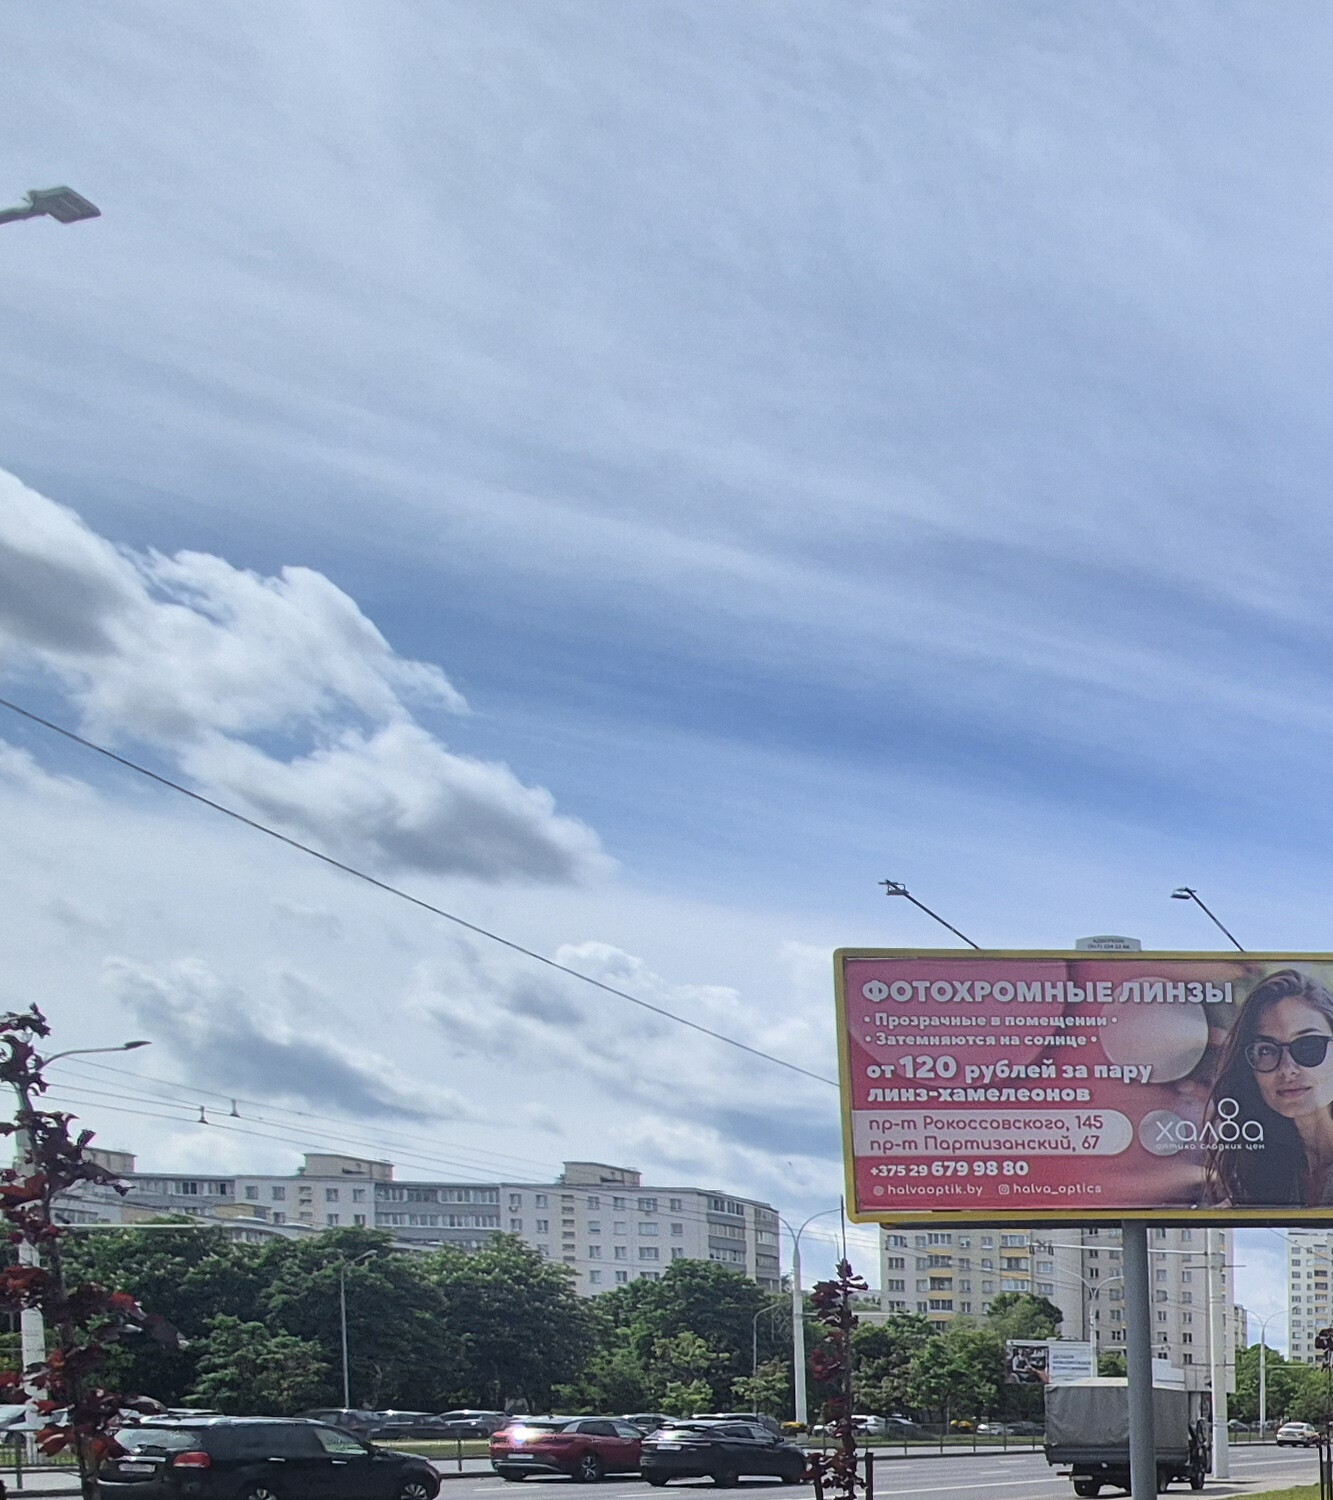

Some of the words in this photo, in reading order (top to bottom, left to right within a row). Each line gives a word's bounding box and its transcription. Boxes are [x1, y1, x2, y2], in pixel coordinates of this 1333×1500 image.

[862, 980, 1113, 1004] ФОТОХРОМНЫЕ
[1119, 981, 1233, 1004] ЛИНЗЫ
[875, 1012, 987, 1029] Прозрачные
[991, 1016, 1001, 1026] в
[1005, 1016, 1108, 1029] помещении
[876, 1032, 996, 1046] Затемняются
[1000, 1034, 1020, 1045] на
[1024, 1035, 1088, 1048] солнце
[866, 1065, 895, 1079] от
[899, 1055, 957, 1079] 120
[965, 1059, 1057, 1084] рублей
[1062, 1064, 1088, 1079] за
[1094, 1064, 1153, 1084] пару
[868, 1087, 1091, 1102] линз-хамелеонов
[869, 1118, 917, 1134] пр-т
[923, 1115, 1070, 1133] Рокоссовского,
[1075, 1115, 1104, 1130] 145
[870, 1139, 918, 1154] пр-т
[924, 1135, 1077, 1154] Партизанский,
[1081, 1135, 1101, 1150] 67
[870, 1165, 906, 1177] +375
[909, 1165, 928, 1177] 29
[931, 1161, 969, 1177] 679
[973, 1161, 998, 1176] 98
[1002, 1160, 1029, 1176] 80
[888, 1184, 984, 1196] halvaoptik.by
[1013, 1183, 1102, 1196] halva_optics
